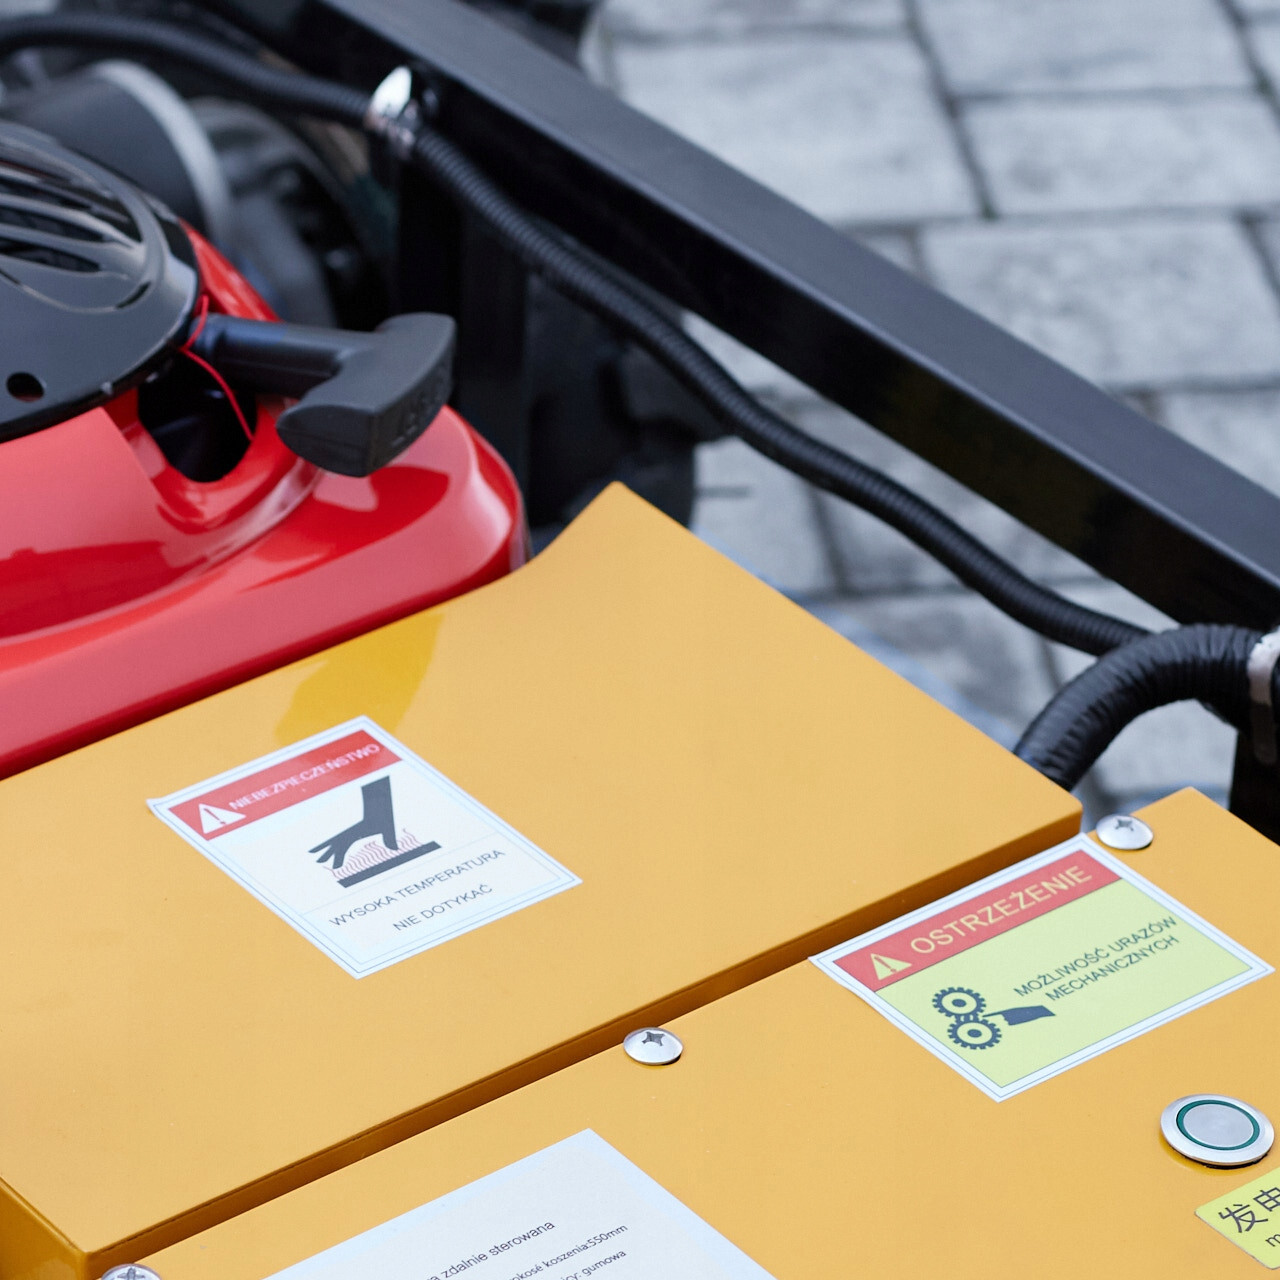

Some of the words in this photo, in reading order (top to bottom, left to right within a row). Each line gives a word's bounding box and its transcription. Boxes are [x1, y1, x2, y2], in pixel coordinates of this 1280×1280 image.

[329, 895, 397, 925] WYSOKA
[394, 849, 504, 897] TEMPERATURA
[392, 915, 421, 930] NIE
[419, 883, 492, 918] DOTYKAĆ
[910, 865, 1091, 953] OSTRZEŻENIE
[1013, 947, 1109, 996] MOŻLIWOŚĆ
[1107, 916, 1176, 951] URAZÓW
[1044, 935, 1178, 1000] MECHANICZNYCH
[440, 1253, 488, 1278] zdalnie
[488, 1222, 555, 1255] sterowana
[581, 1250, 626, 1275] gumowa
